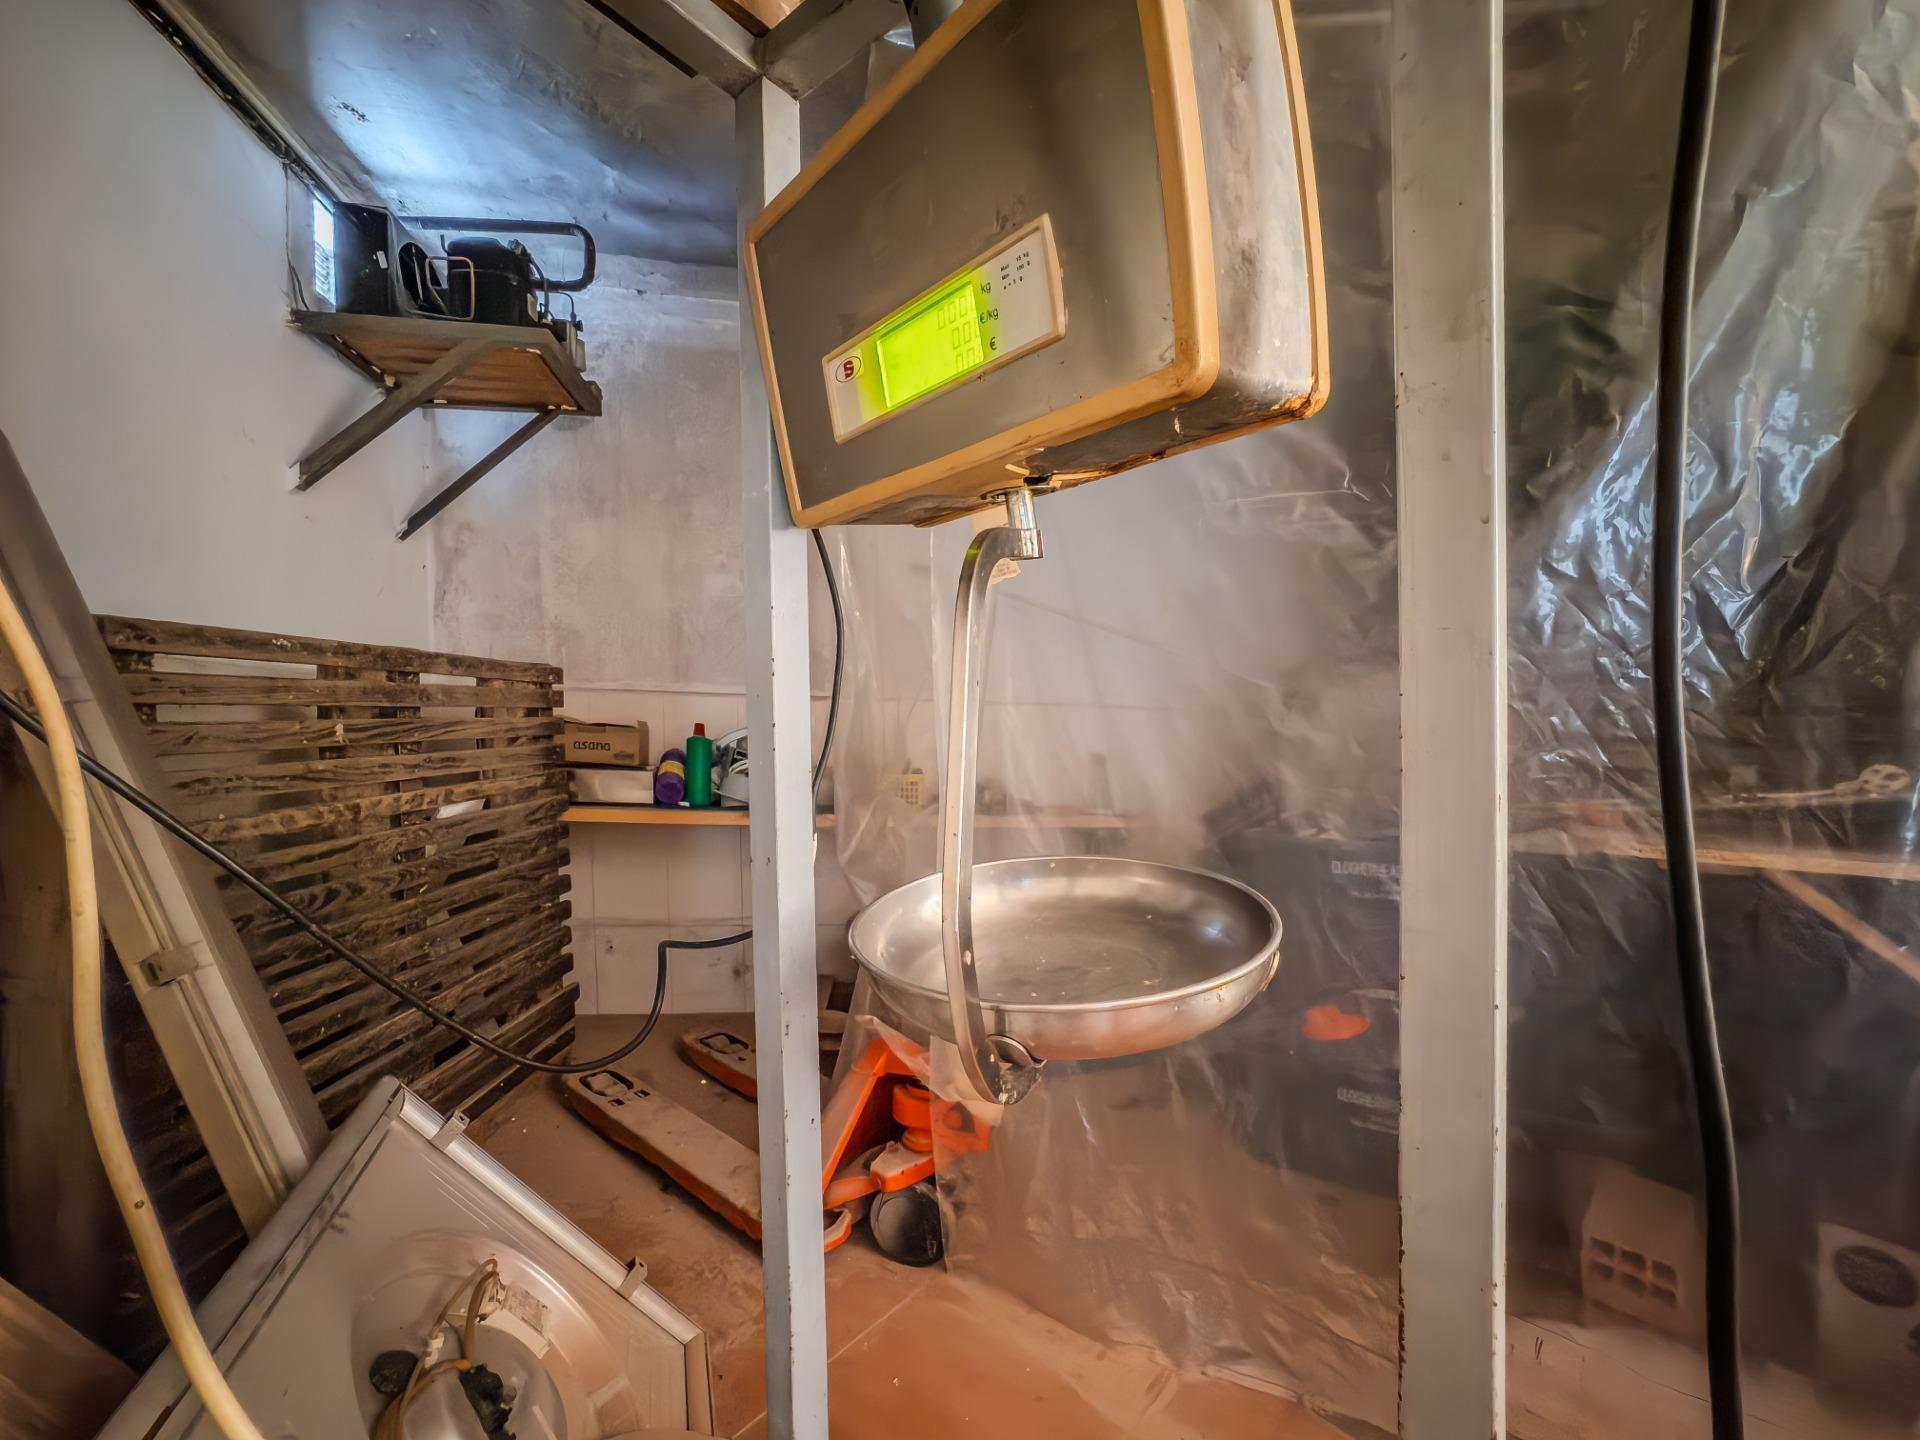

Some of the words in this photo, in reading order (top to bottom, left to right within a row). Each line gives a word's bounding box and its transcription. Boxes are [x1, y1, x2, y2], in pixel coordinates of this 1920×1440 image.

[981, 282, 991, 294] kg
[979, 308, 999, 324] €/kg
[989, 336, 998, 351] €
[573, 740, 611, 751] asana
